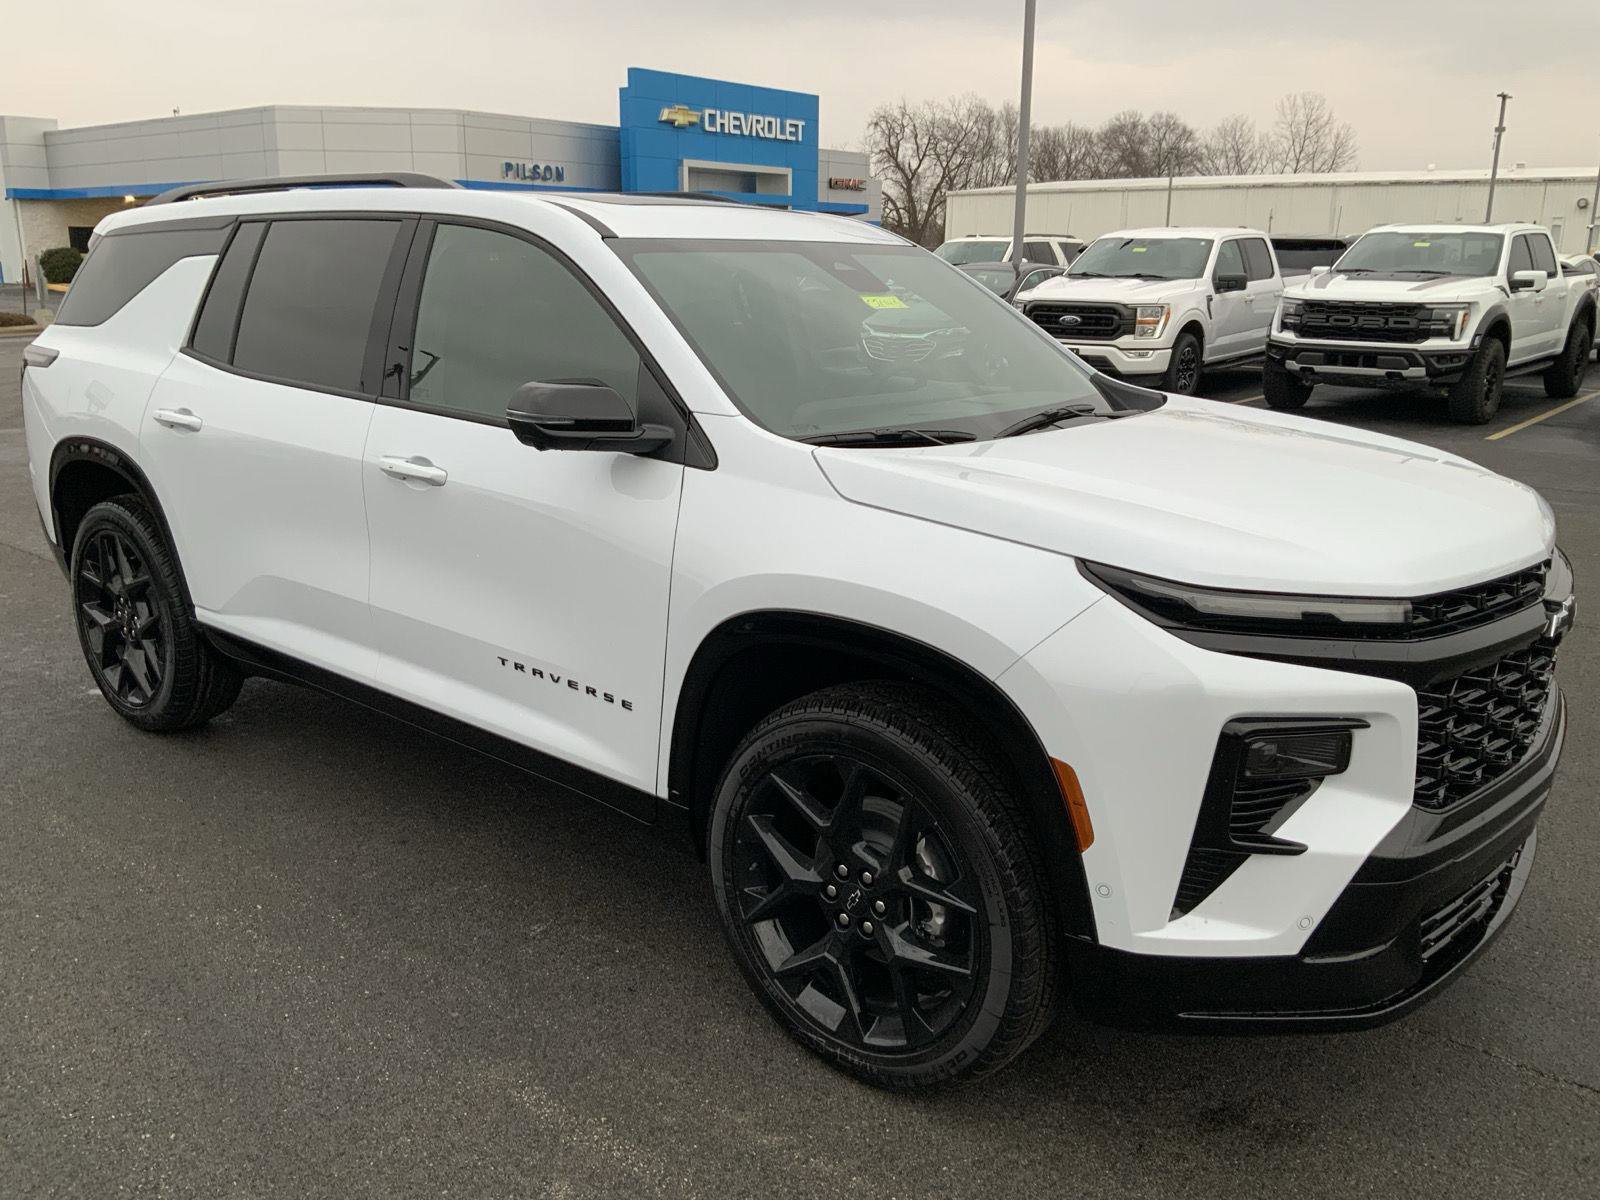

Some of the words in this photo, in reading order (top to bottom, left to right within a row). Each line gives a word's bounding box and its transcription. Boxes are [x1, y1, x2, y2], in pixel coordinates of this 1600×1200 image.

[704, 109, 805, 142] CHEVROLET
[504, 161, 564, 182] PILSON
[1301, 314, 1420, 329] FORD
[497, 656, 633, 712] TRAVERSE
